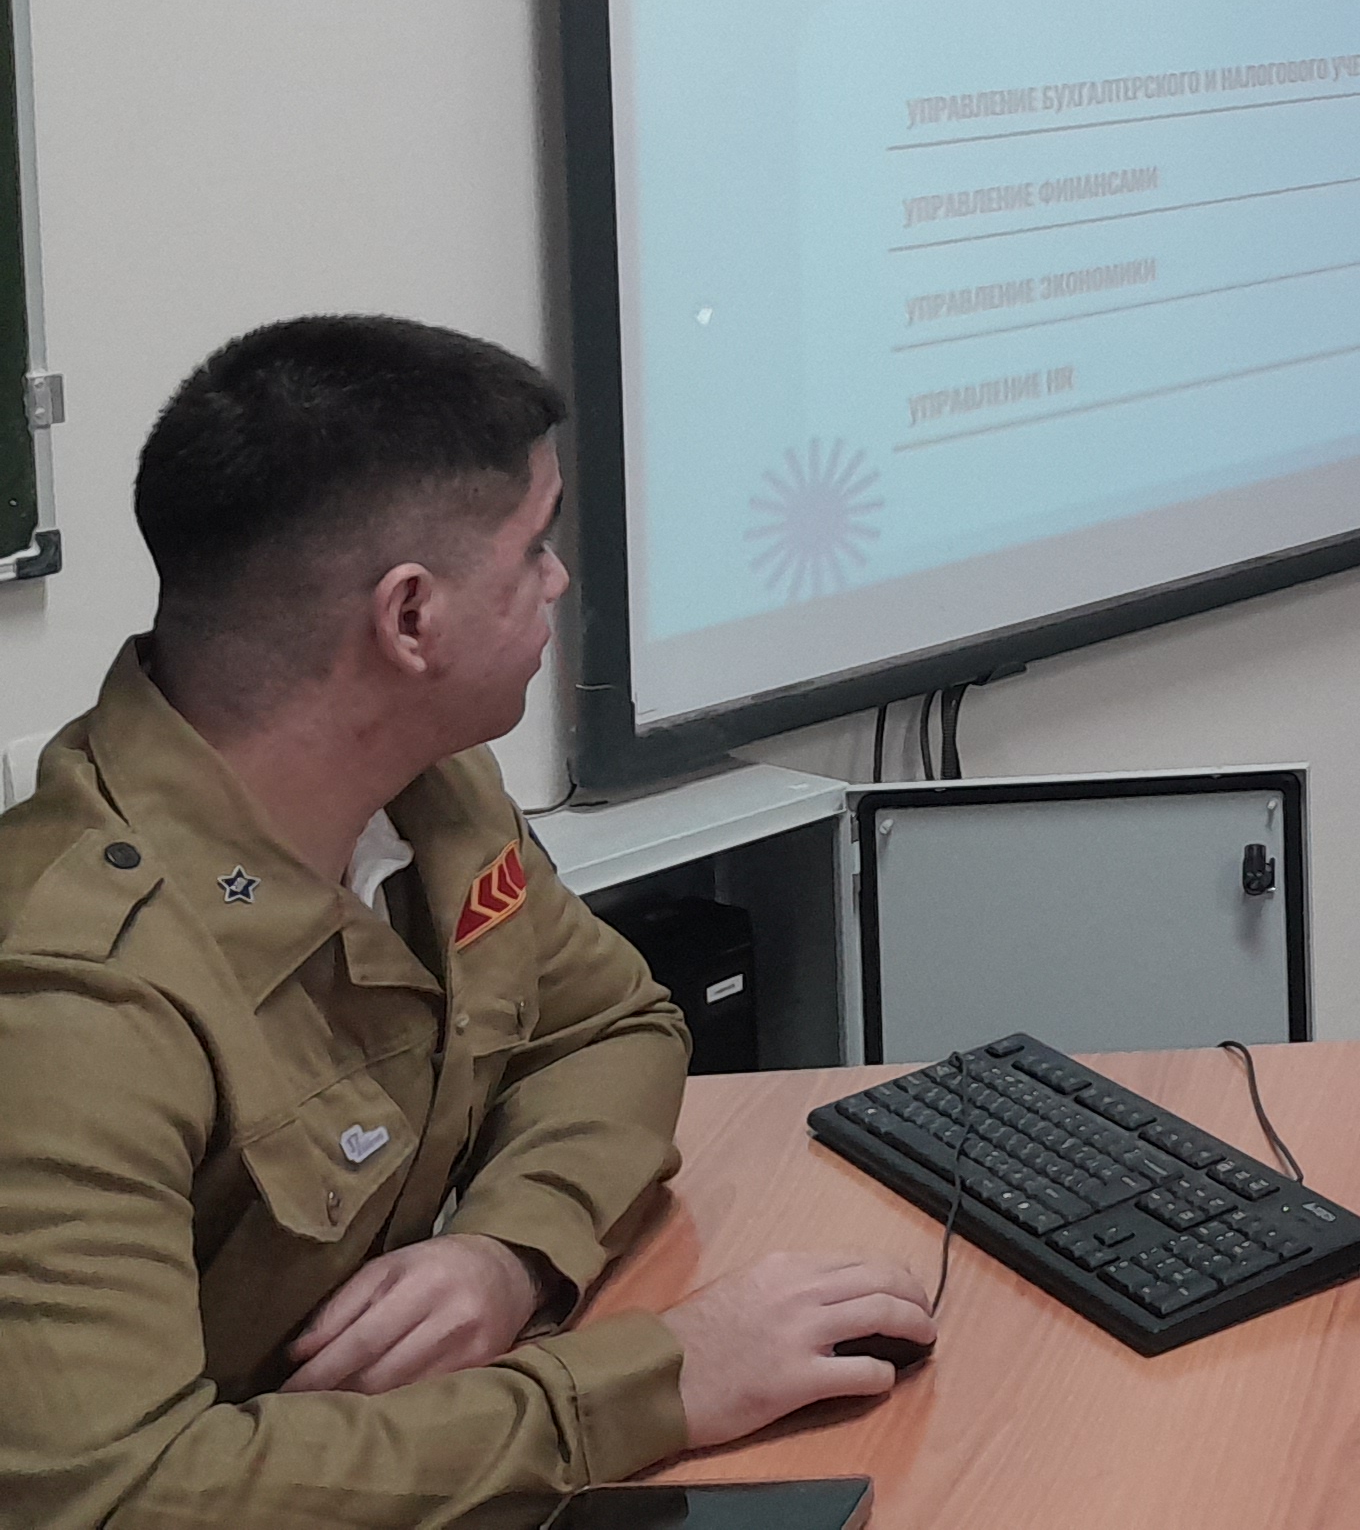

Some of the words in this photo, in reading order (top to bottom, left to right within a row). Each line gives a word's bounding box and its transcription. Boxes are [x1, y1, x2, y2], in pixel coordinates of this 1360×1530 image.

[906, 86, 1038, 129] УПРАВЛЕНИЕ
[1042, 70, 1200, 111] БУХГАЛТЕРСКОГО
[1204, 69, 1217, 92] И
[1221, 58, 1328, 91] НАЛОГОВОГО
[903, 182, 1034, 228] УПРАВЛЕНИЕ
[1038, 166, 1159, 205] ФИНАНСАМИ
[906, 275, 1035, 326] УПРАВЛЕНИЕ
[908, 372, 1041, 427] УПРАВЛЕНИЕ
[1047, 365, 1074, 394] HR
